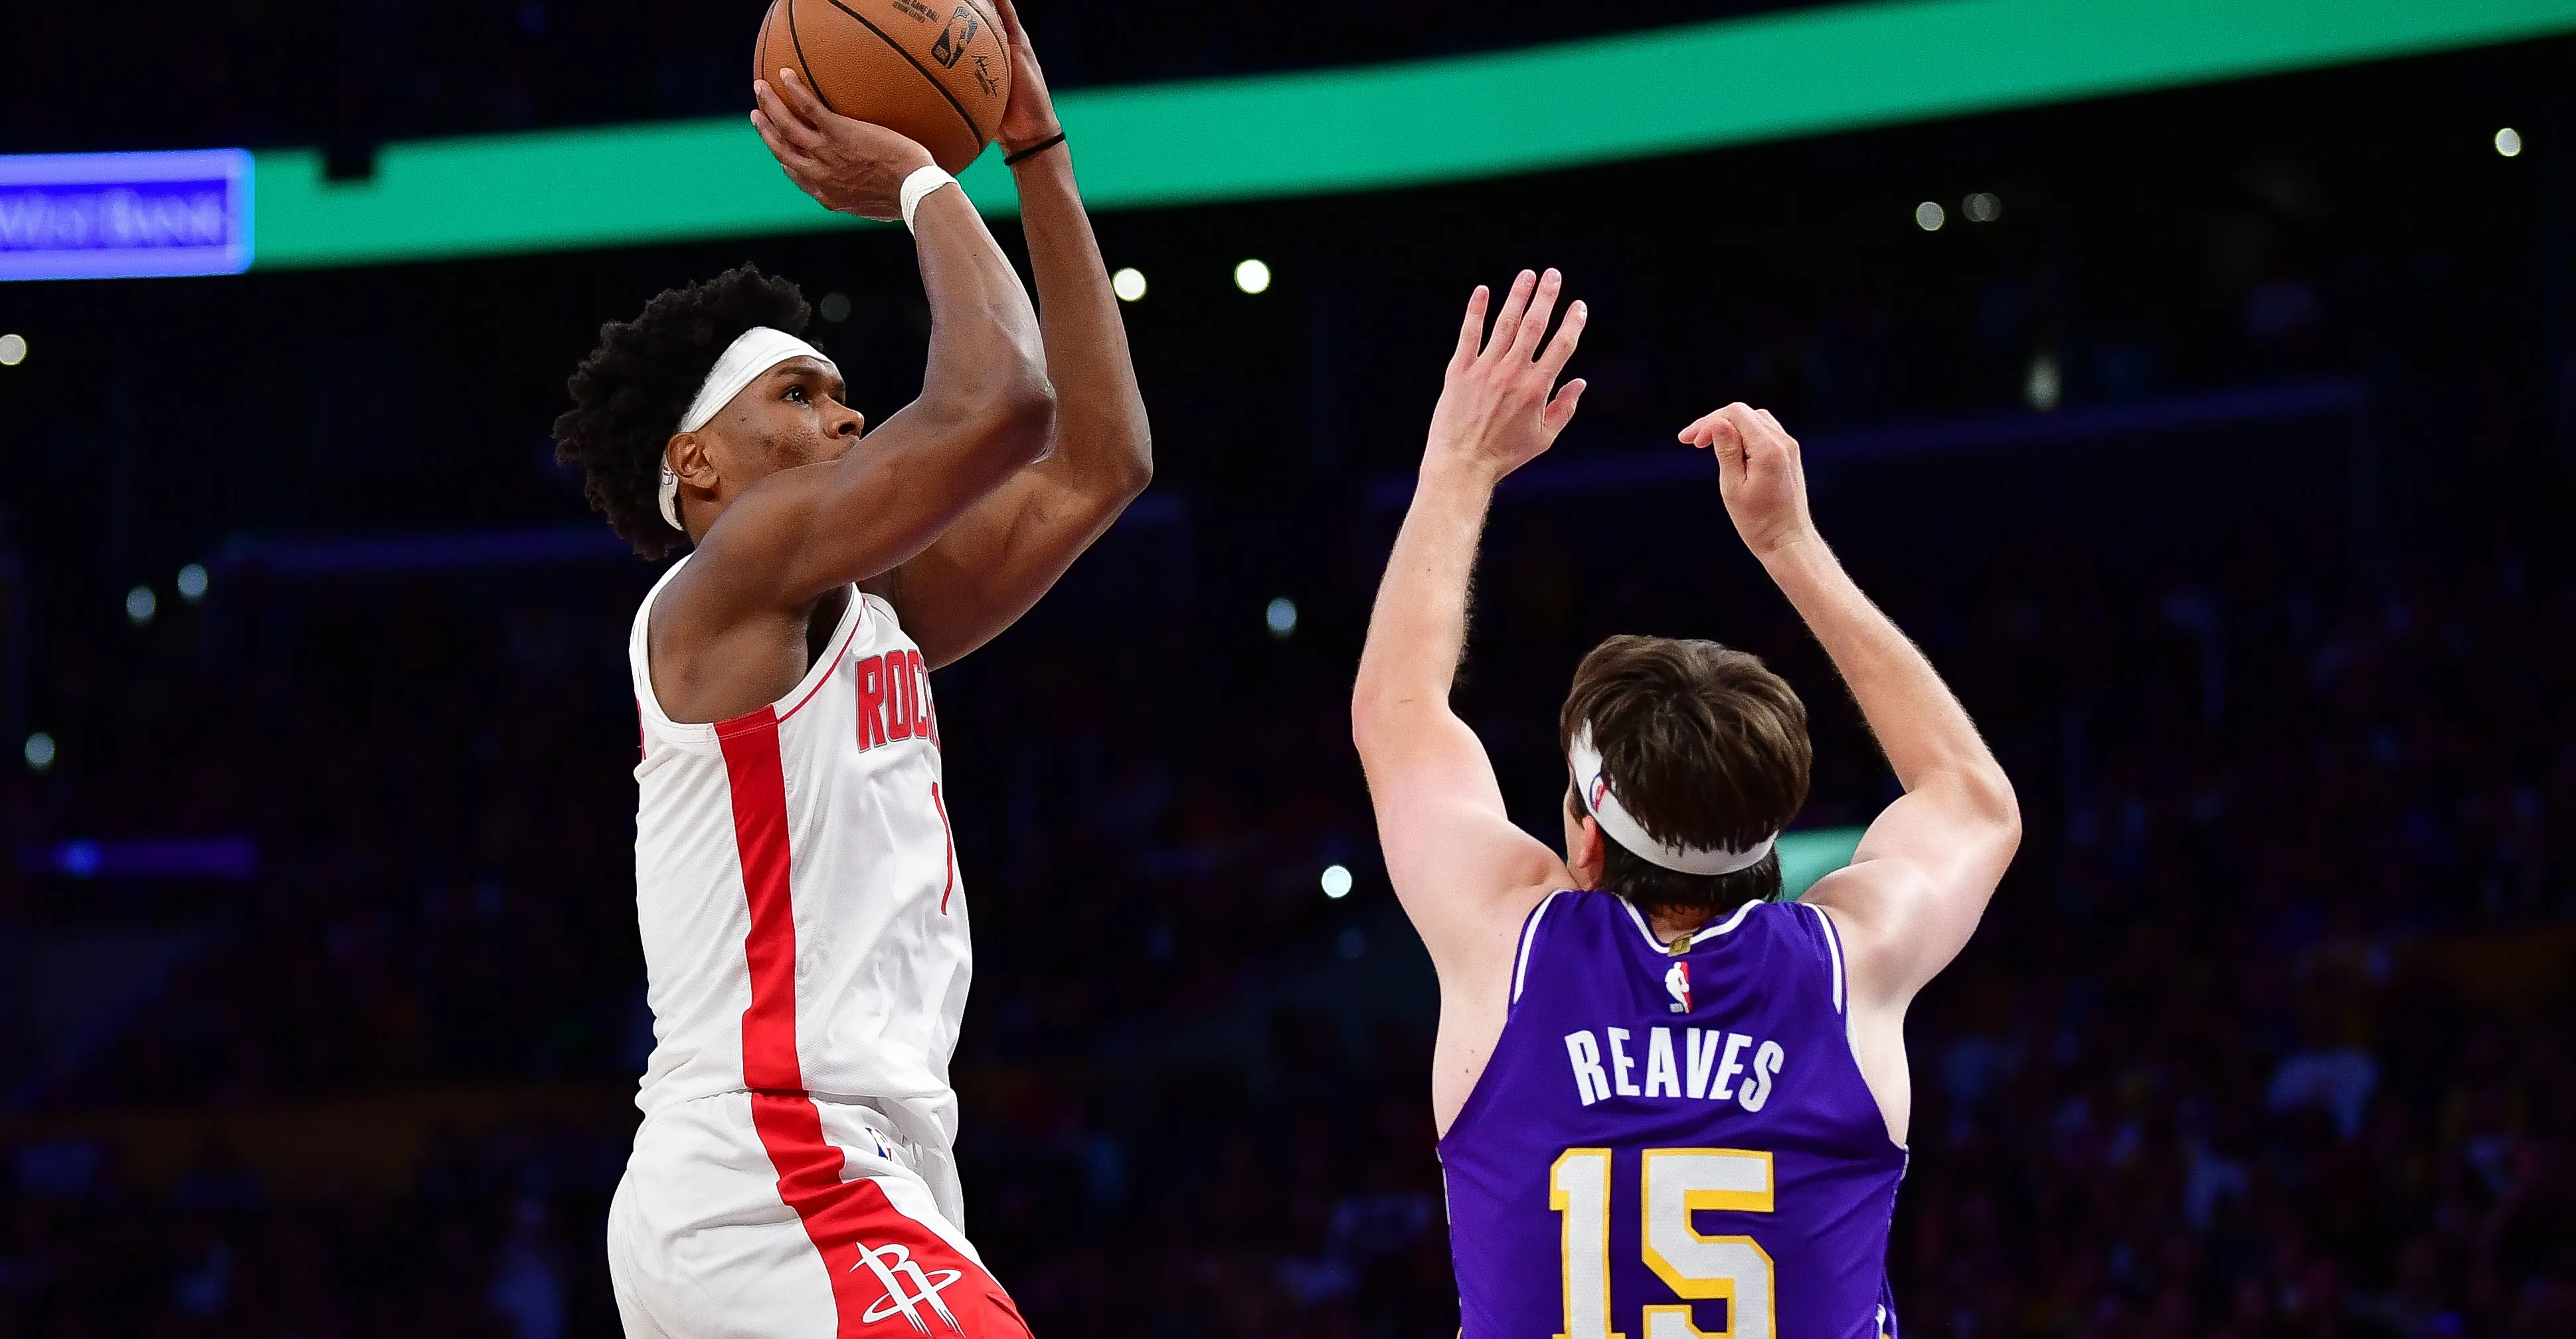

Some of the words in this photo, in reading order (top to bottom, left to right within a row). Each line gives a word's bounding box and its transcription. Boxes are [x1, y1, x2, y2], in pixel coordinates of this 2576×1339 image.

[855, 648, 941, 755] ROC
[1564, 1026, 1785, 1113] REAVES
[1549, 1147, 1775, 1339] 15
